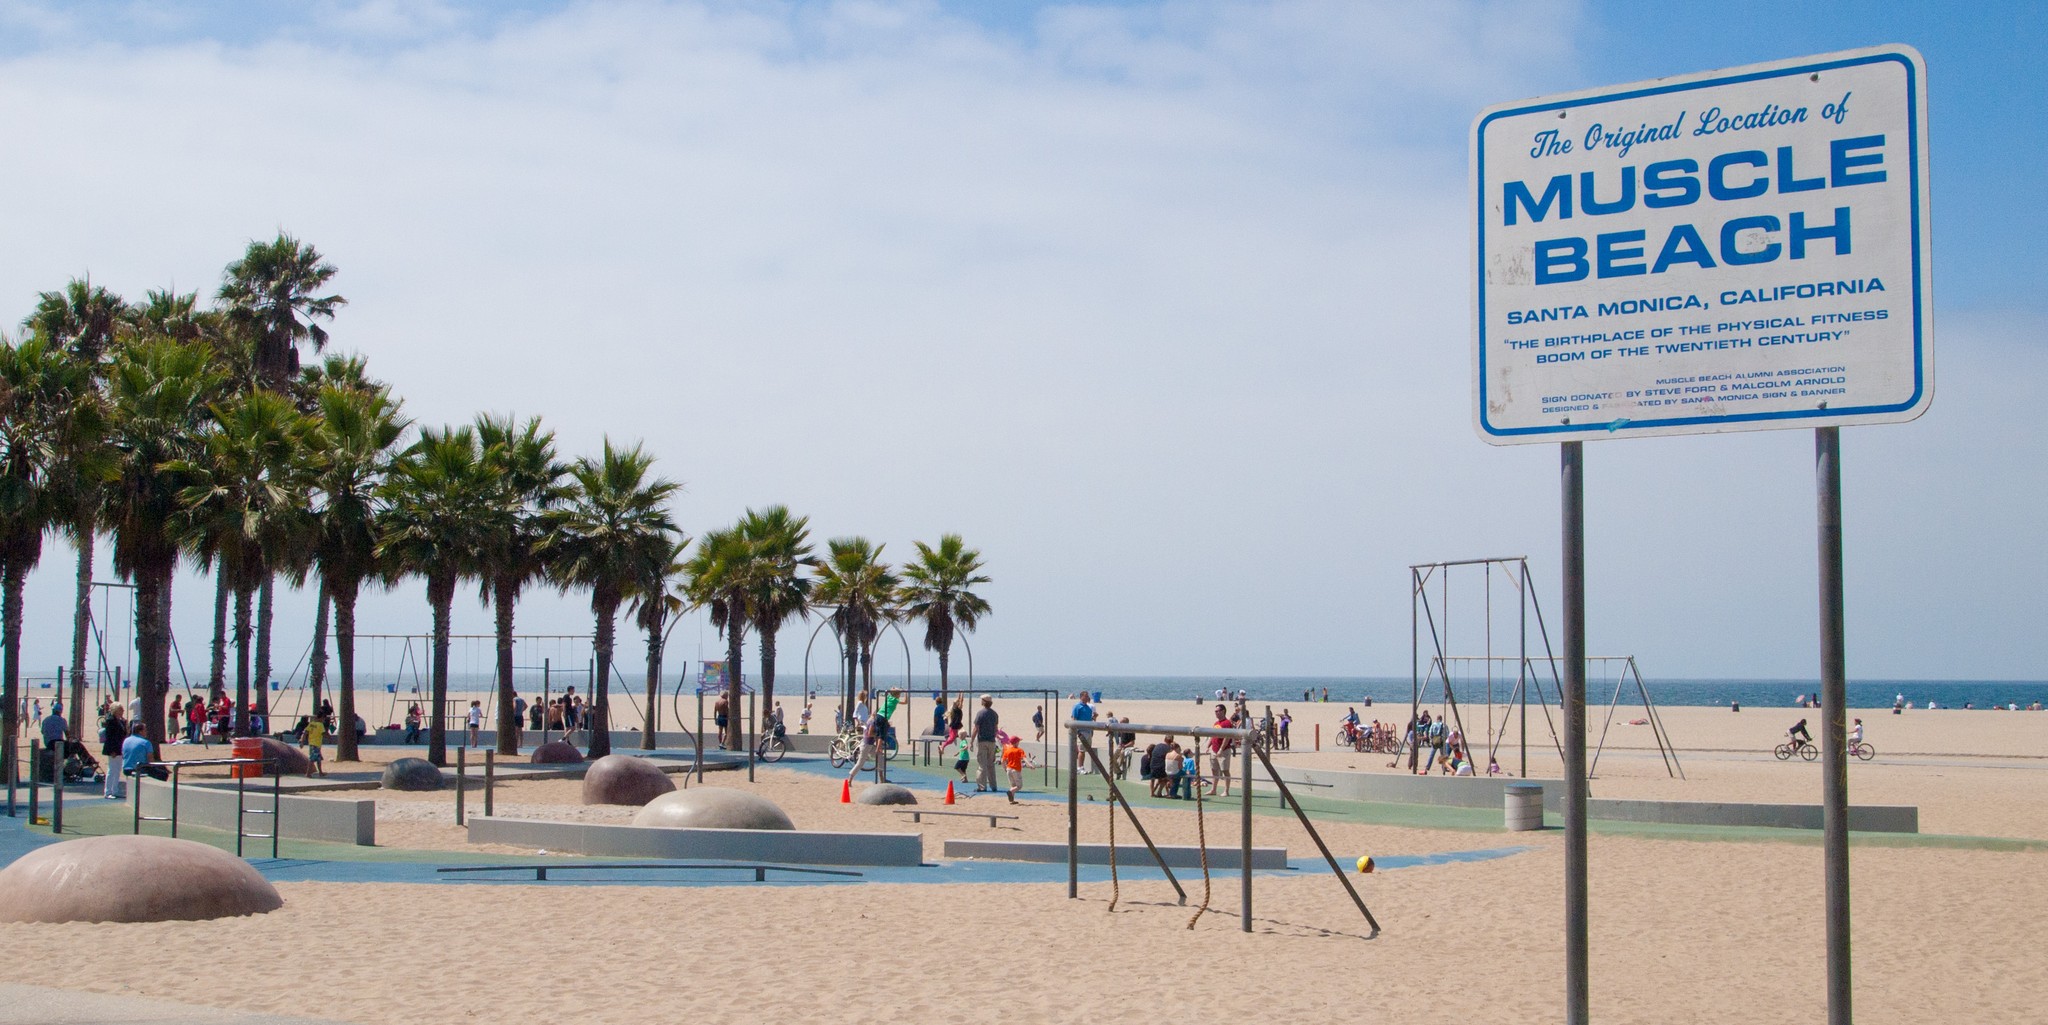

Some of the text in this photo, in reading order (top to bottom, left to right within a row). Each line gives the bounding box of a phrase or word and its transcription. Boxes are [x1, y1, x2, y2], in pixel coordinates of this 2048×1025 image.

[1530, 91, 1852, 159] The Original Location of
[1503, 134, 1887, 226] MUSCLE
[1534, 206, 1851, 286] BEACH
[1507, 277, 1886, 325] SANTA MONICA, CALIFORNIA
[1544, 330, 1645, 348] BIRTHPLACE
[1650, 327, 1673, 339] OF
[1678, 324, 1711, 336] THE
[1717, 316, 1806, 333] PHYSICAL
[1811, 309, 1889, 325] FITNESS
[1536, 351, 1585, 364] BOOM
[1590, 349, 1613, 360] OF
[1617, 346, 1650, 357] THE
[1655, 338, 1752, 354] TWENTIETH
[1541, 395, 1567, 404] SIGN
[1626, 390, 1641, 398] BY
[1644, 387, 1682, 397] STEVE
[1684, 385, 1716, 394] FORD
[1719, 384, 1729, 392] &
[1731, 380, 1791, 391] MALCOLM
[1794, 376, 1846, 386] ARNOLD
[1655, 366, 1846, 385] MUSCLE BEACH ALUMNI ASSOCIATION
[1541, 404, 1590, 414] DESIGNED
[1592, 403, 1600, 411] &
[1601, 399, 1662, 410] FACATED
[1717, 393, 1759, 402] MONICA
[1762, 391, 1787, 399] SIGN
[1800, 387, 1846, 396] BANNER
